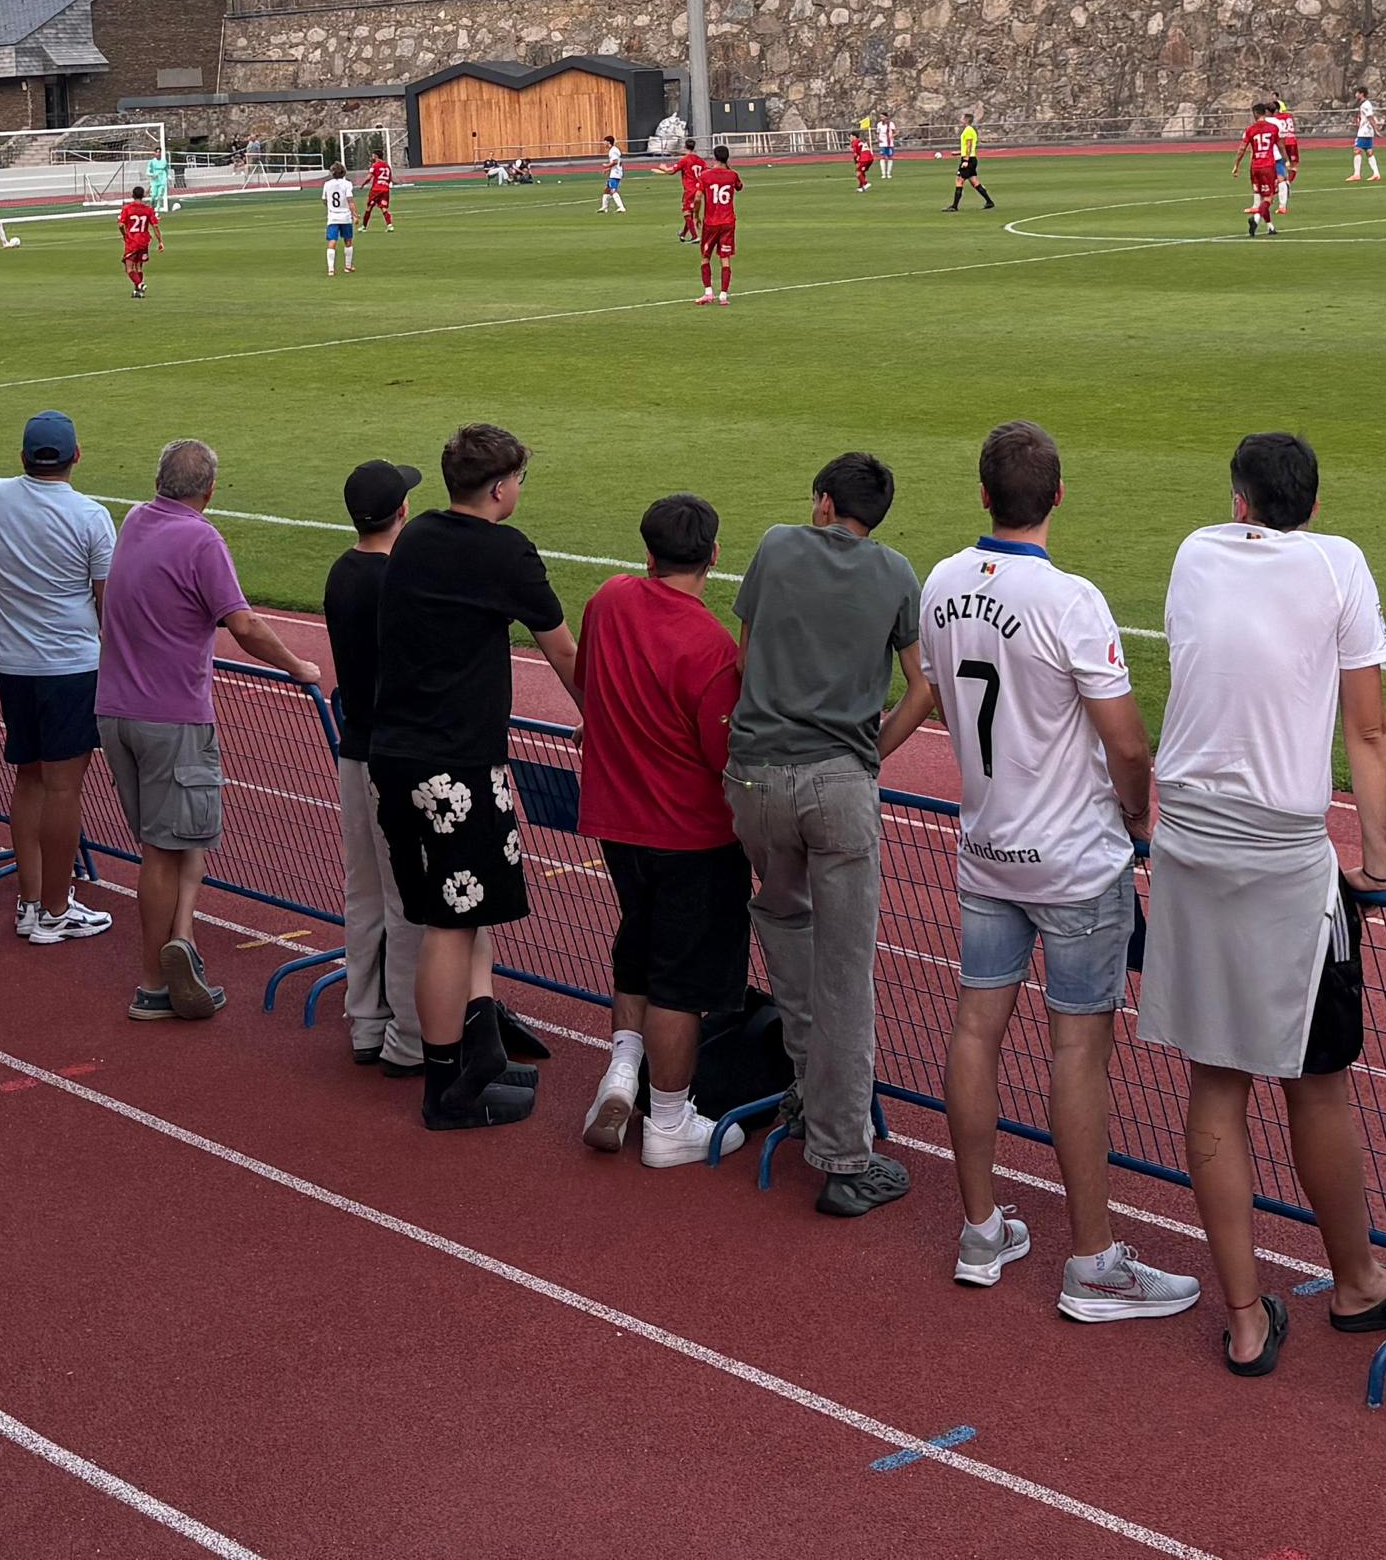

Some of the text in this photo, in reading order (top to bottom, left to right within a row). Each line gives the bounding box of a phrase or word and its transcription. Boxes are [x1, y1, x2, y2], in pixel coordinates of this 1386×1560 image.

[1253, 132, 1272, 151] 15
[332, 191, 341, 208] 8
[709, 183, 731, 205] 16
[129, 214, 148, 233] 21
[934, 593, 1022, 640] GAZTELU
[956, 659, 1001, 779] 7
[963, 832, 1042, 864] Andorra
